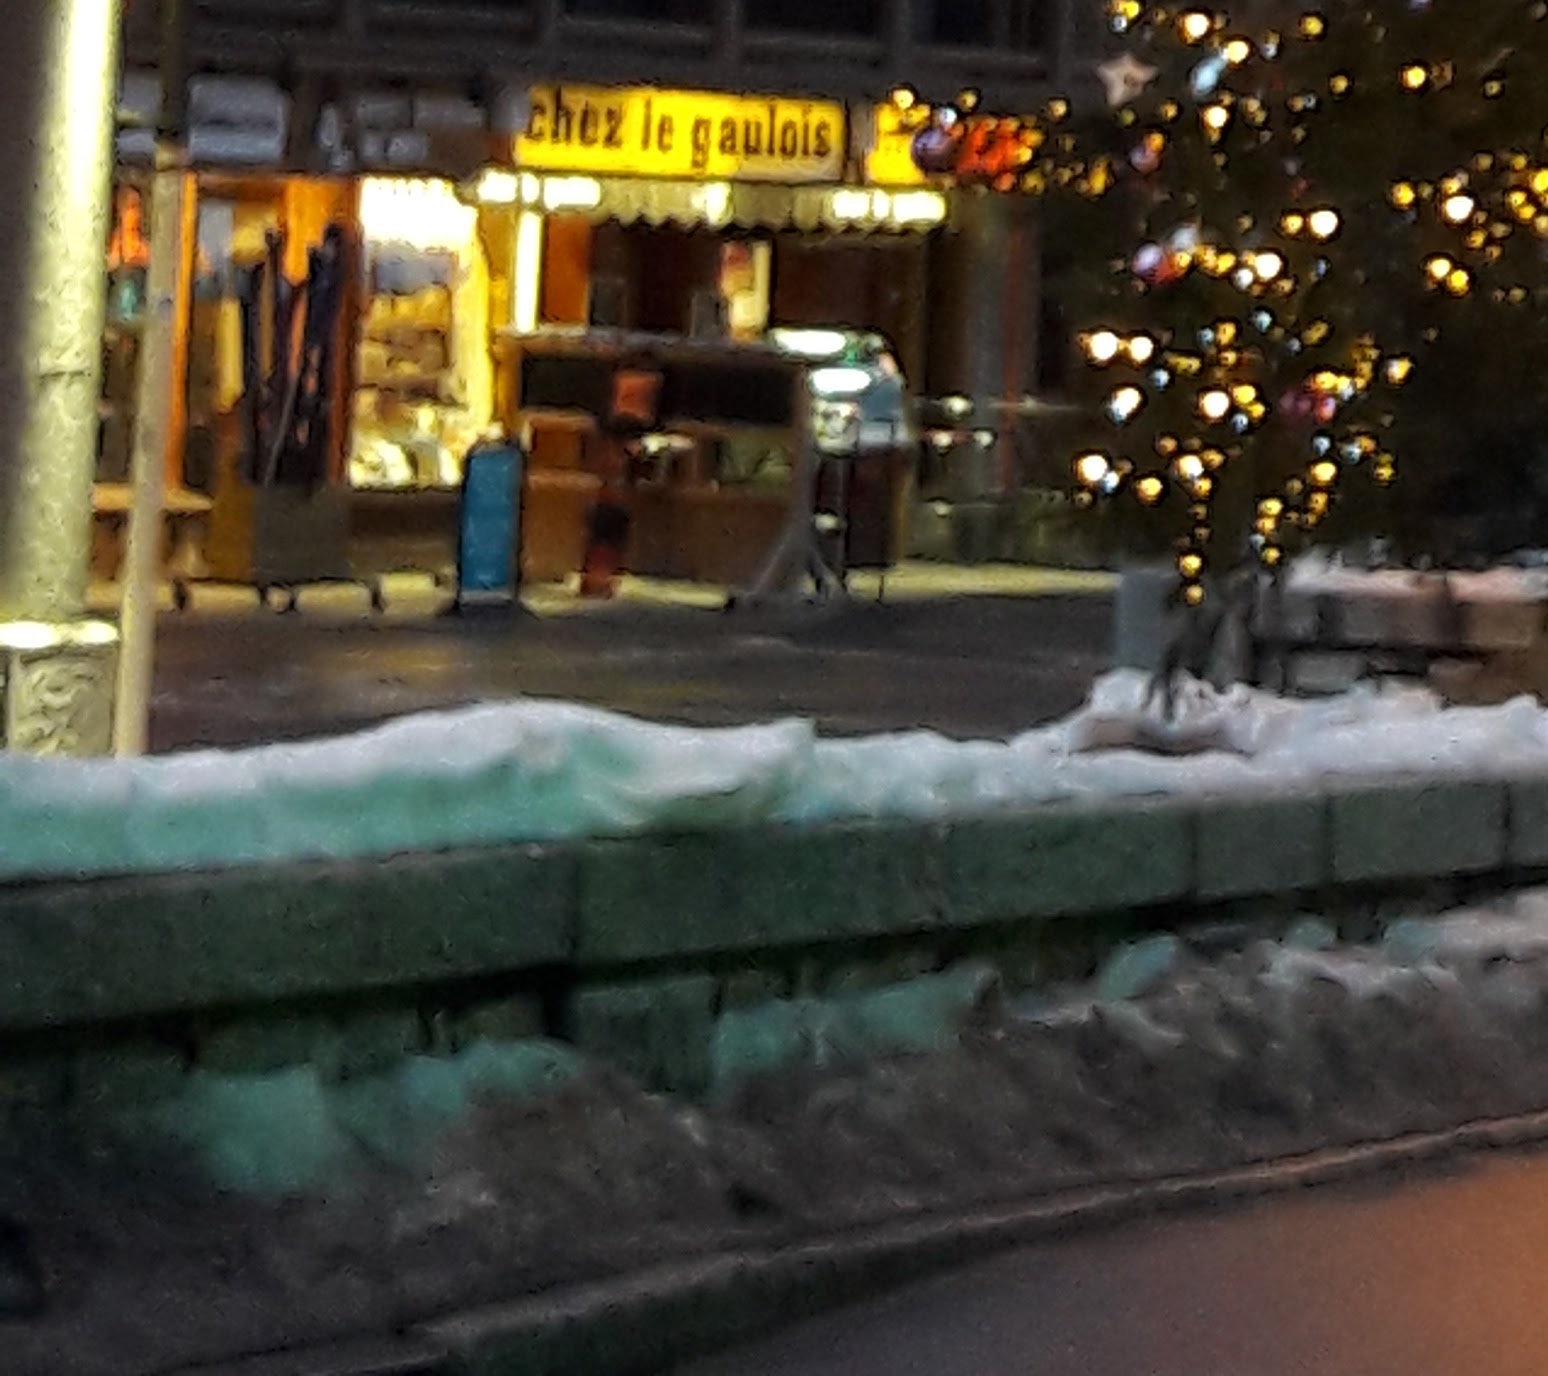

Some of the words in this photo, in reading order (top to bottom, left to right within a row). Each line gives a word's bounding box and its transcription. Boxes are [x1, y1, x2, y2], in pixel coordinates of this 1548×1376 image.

[525, 86, 623, 148] chez
[642, 98, 675, 154] le
[691, 101, 831, 170] gaulois
